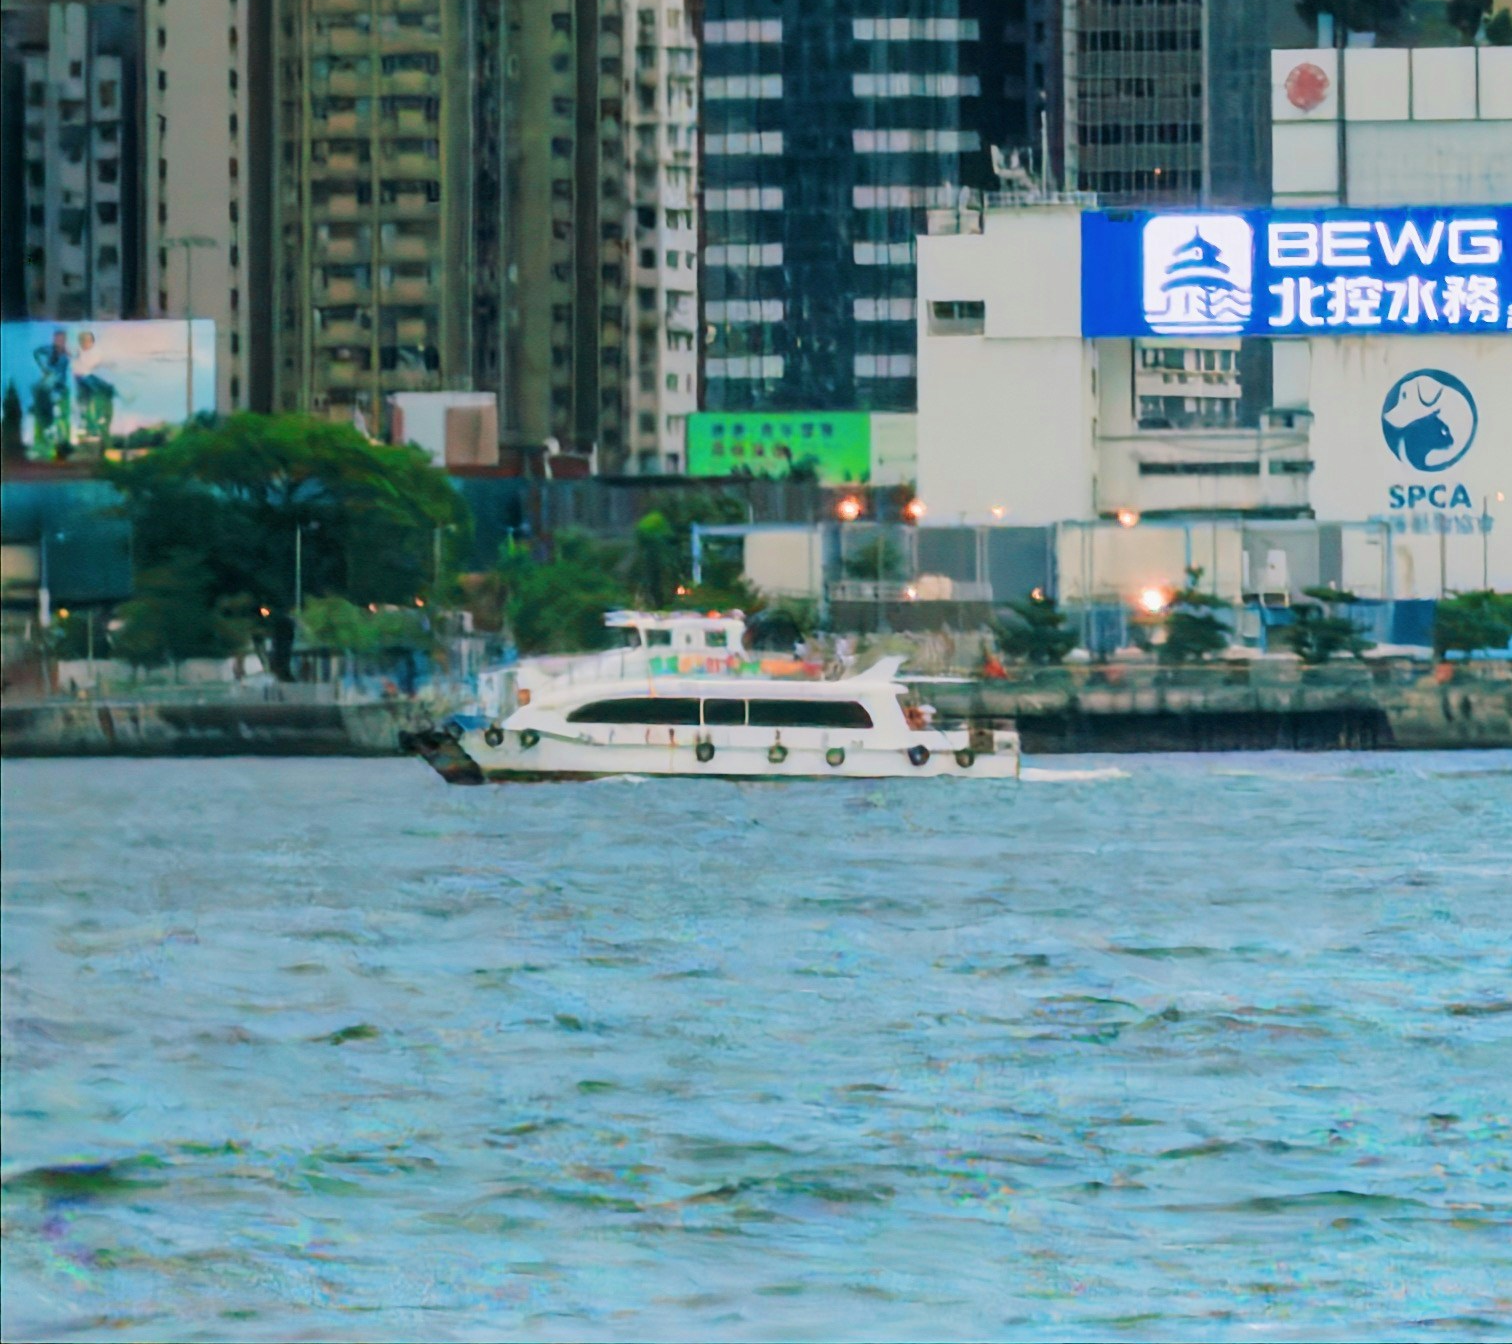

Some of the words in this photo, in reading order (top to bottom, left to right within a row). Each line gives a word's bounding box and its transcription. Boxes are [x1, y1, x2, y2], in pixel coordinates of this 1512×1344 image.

[1267, 219, 1502, 267] BEWG
[1267, 275, 1500, 327] 北控水務
[1388, 483, 1472, 509] SPCA
